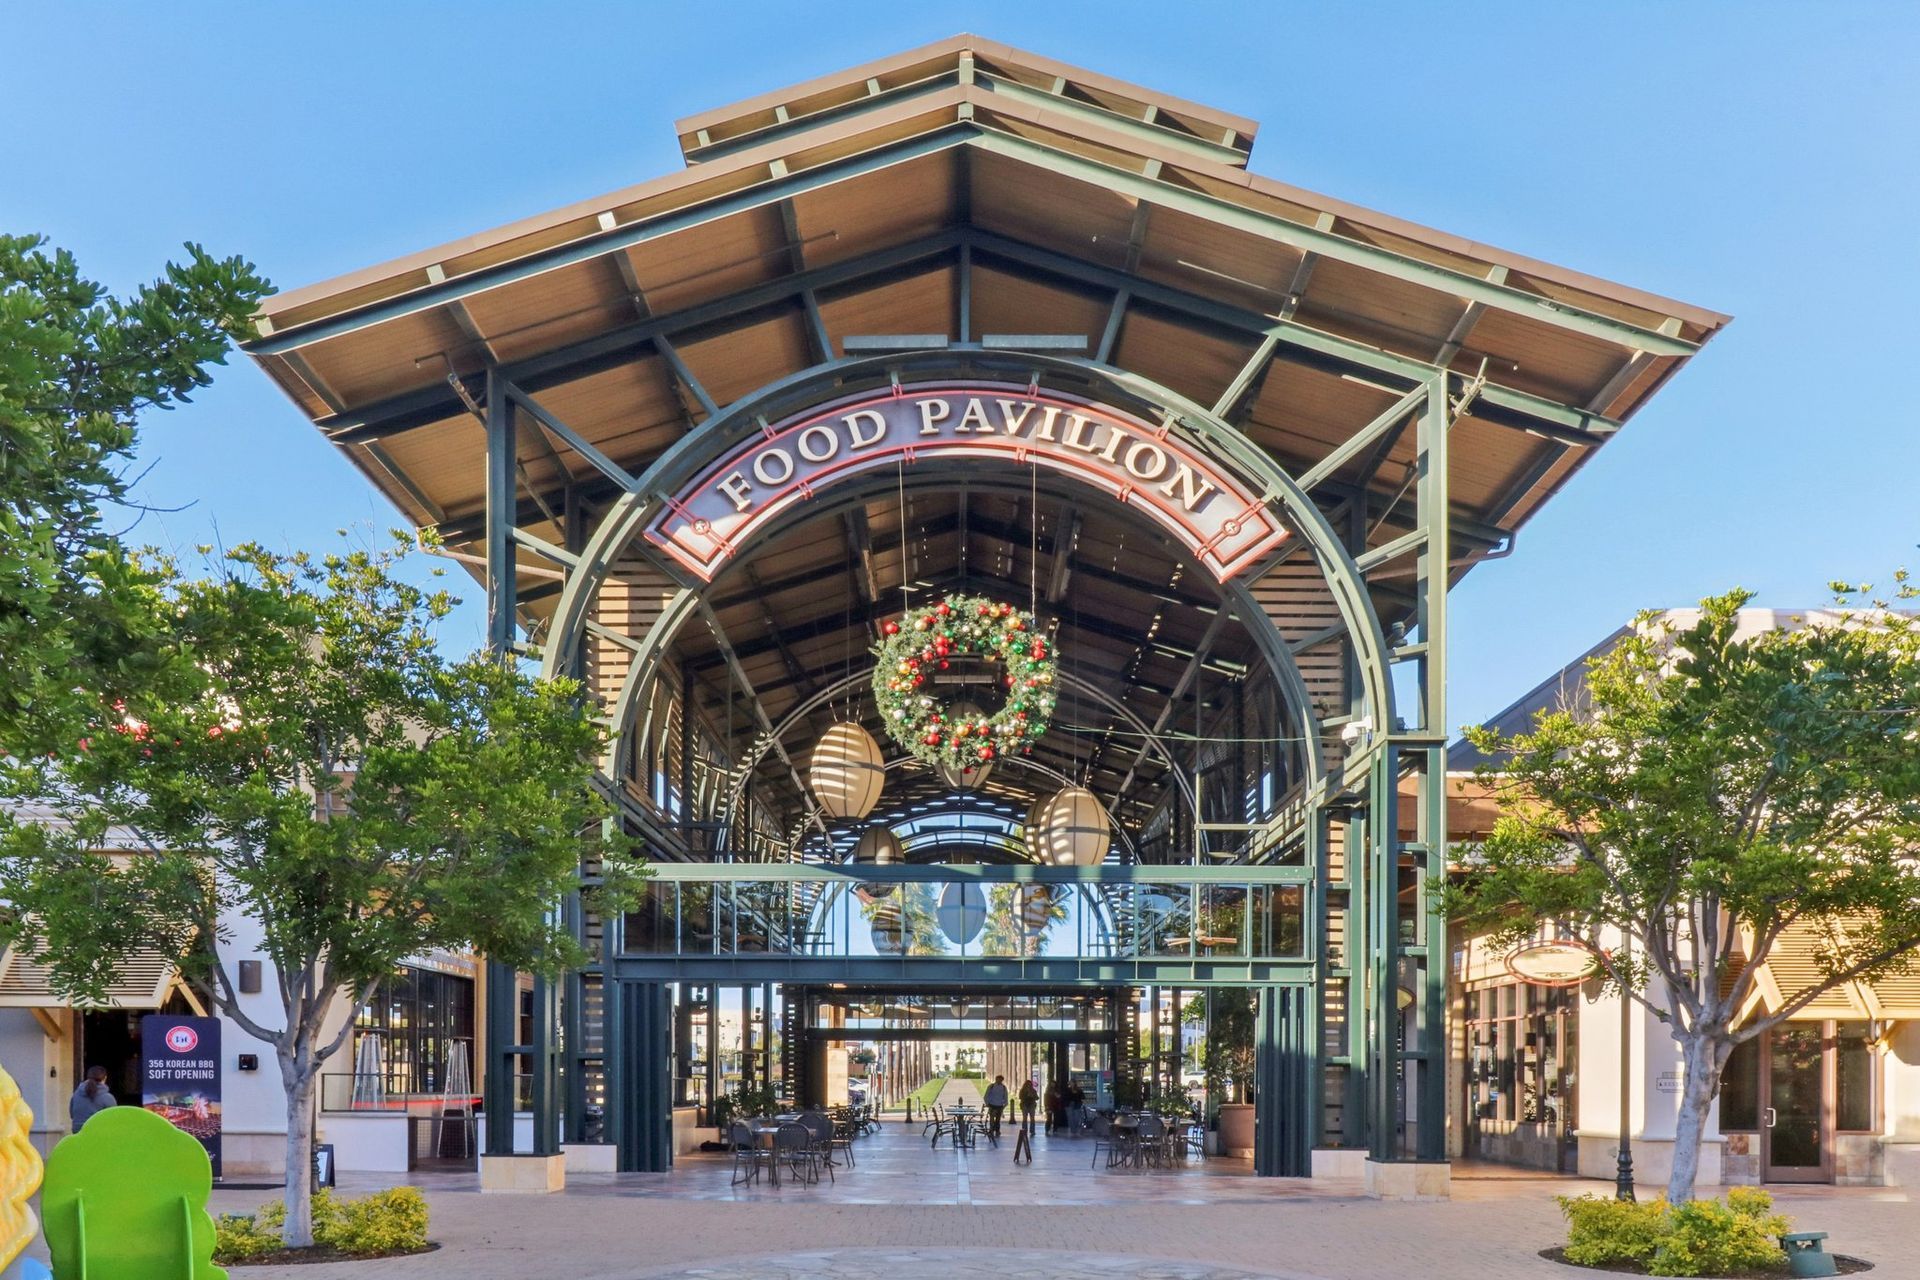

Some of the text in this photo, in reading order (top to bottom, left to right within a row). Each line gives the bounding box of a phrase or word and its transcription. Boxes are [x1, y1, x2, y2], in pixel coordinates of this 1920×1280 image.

[716, 398, 1215, 512] FOOD PAVILION
[148, 1060, 214, 1068] 356 KOREAN BBQ
[148, 1069, 214, 1079] SOFT OPENING
